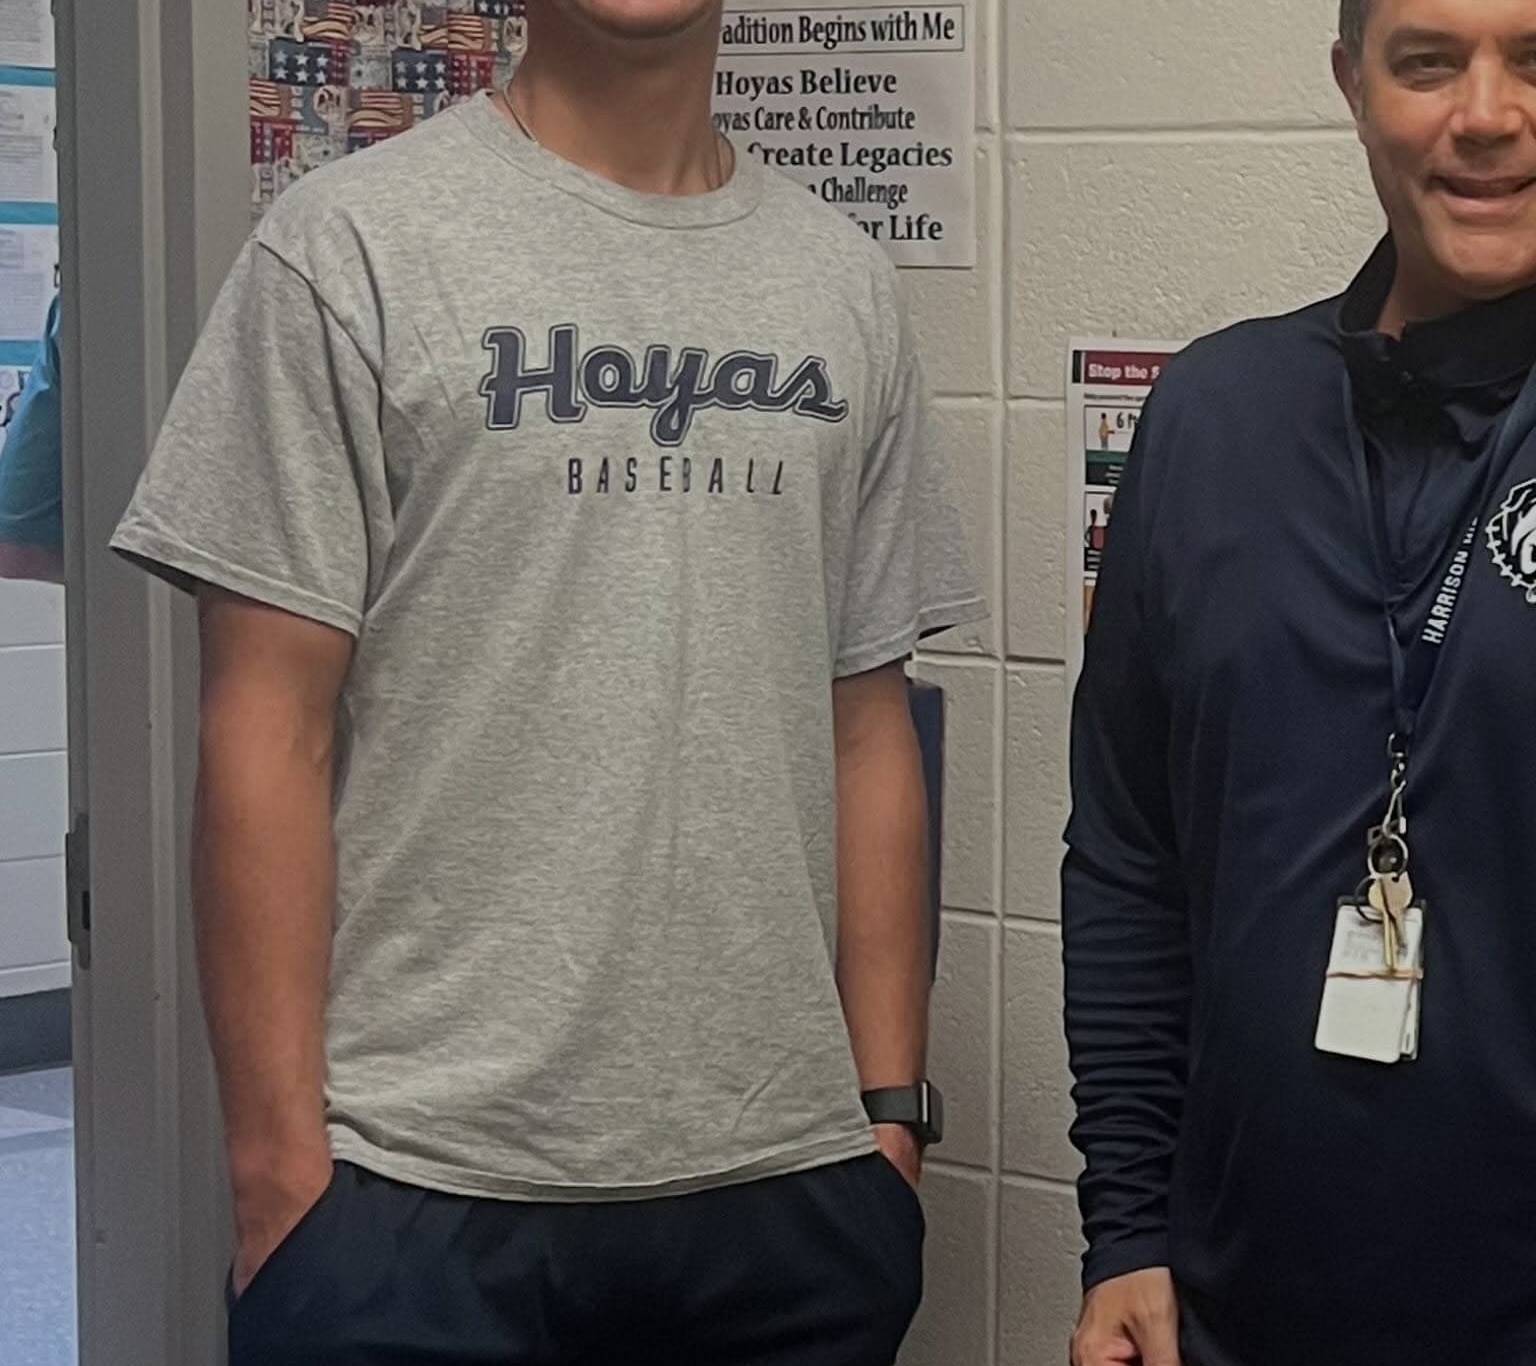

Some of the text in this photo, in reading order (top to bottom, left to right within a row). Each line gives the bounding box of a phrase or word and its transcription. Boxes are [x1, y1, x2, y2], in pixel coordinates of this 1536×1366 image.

[721, 11, 955, 50] adition Begins with Me
[715, 68, 897, 101] Hoyas Believe
[755, 106, 794, 131] Care
[798, 106, 812, 131] &
[816, 103, 916, 131] Contribute
[840, 141, 953, 173] Legacies
[821, 176, 909, 210] Challenge
[848, 212, 944, 241] or Life
[479, 322, 850, 447] Hoyas
[1088, 363, 1122, 380] Stop
[1124, 365, 1149, 379] the
[567, 455, 784, 496] BASEBALL
[1421, 550, 1469, 645] HARRISON
